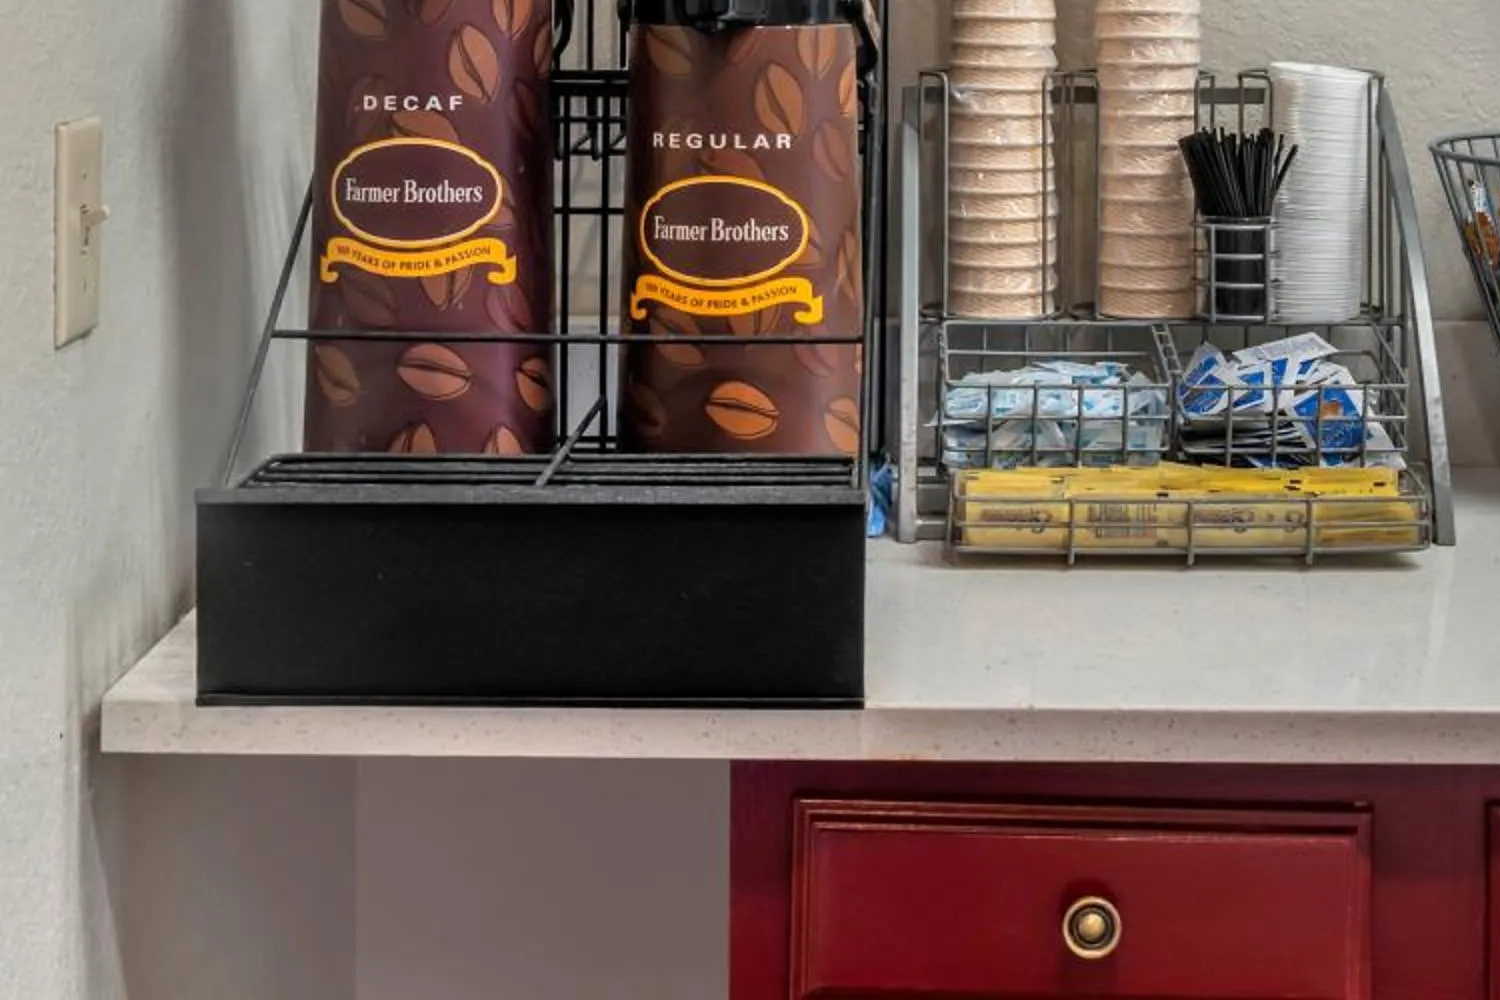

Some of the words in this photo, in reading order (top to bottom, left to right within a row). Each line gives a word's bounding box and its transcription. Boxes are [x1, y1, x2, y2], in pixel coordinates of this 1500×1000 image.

[363, 95, 464, 111] DECAF
[653, 132, 792, 149] REGULAR
[345, 177, 400, 203] Farmer
[404, 179, 483, 204] Brothers
[653, 215, 709, 241] Farmer
[711, 217, 789, 242] Brothers
[382, 259, 396, 270] OF
[399, 259, 430, 271] PRIDE
[445, 245, 491, 265] PASSION
[690, 297, 704, 308] OF
[706, 298, 738, 310] PRIDE
[751, 285, 798, 304] PASSION
